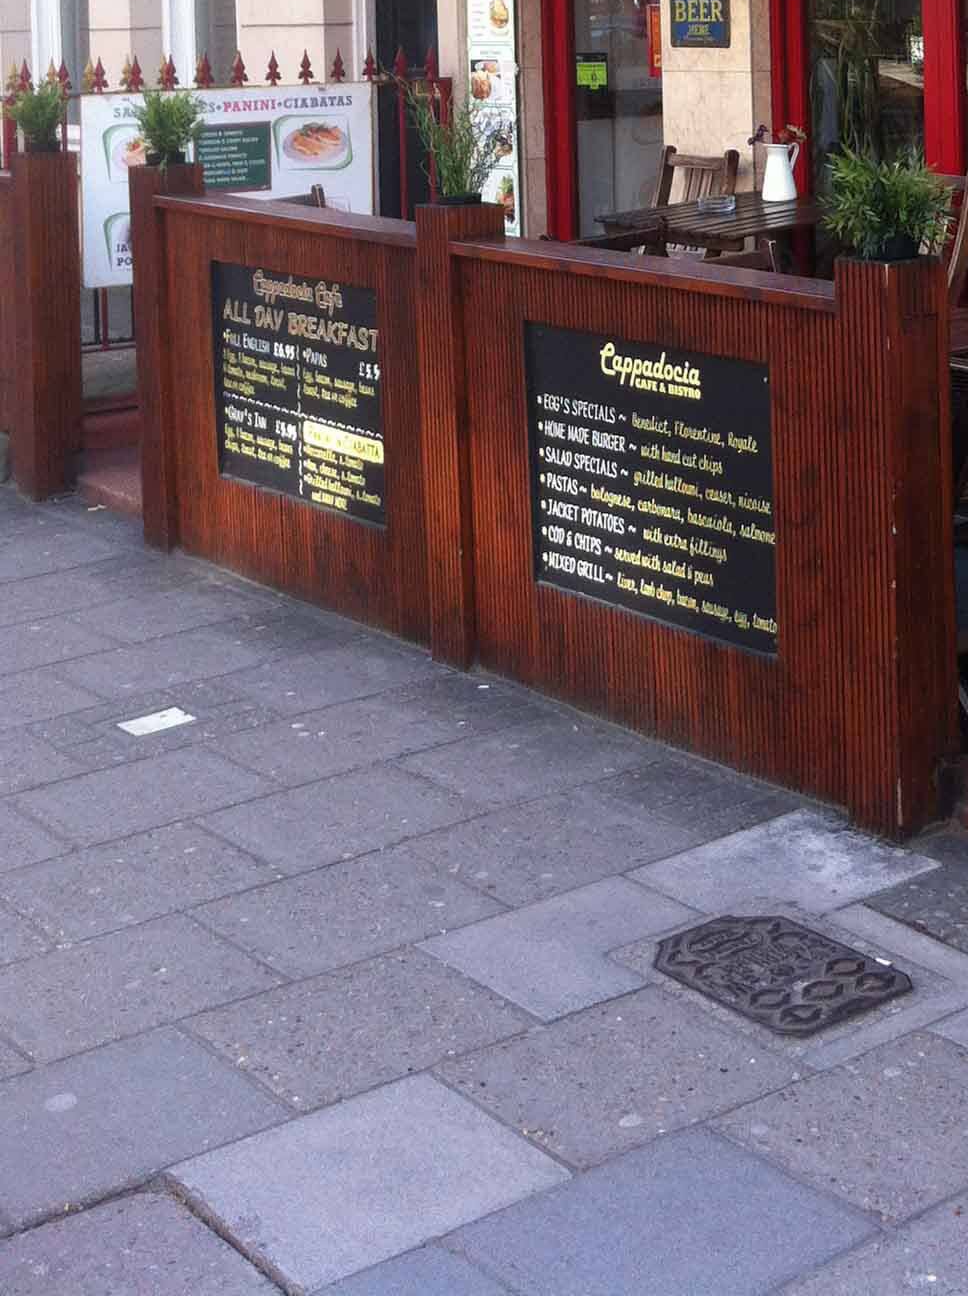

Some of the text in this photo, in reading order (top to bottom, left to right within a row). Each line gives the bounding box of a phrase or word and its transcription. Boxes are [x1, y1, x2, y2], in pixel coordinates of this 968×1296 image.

[674, 0, 726, 22] BEER
[223, 99, 276, 113] PANINI
[223, 297, 379, 352] ALL DAY BREAKFAST
[600, 342, 701, 387] Cappadocia
[635, 377, 658, 392] CAFE
[668, 383, 701, 400] BISTRO
[543, 393, 570, 414] EGG'S
[572, 400, 616, 424] SPECIALS
[544, 419, 566, 440] HOME
[567, 425, 590, 445] MADE
[592, 430, 626, 453] BURGER
[682, 453, 697, 469] cut
[698, 454, 723, 476] chips
[545, 446, 572, 467] SALAD
[574, 453, 618, 478] SPECIALS
[547, 472, 578, 495] PASTAS
[547, 499, 579, 522] JACKET
[581, 508, 625, 534] POTATOES
[548, 525, 565, 545] COD
[574, 533, 602, 555] CHIPS
[548, 552, 576, 574] MIXED
[577, 560, 605, 583] GRILL
